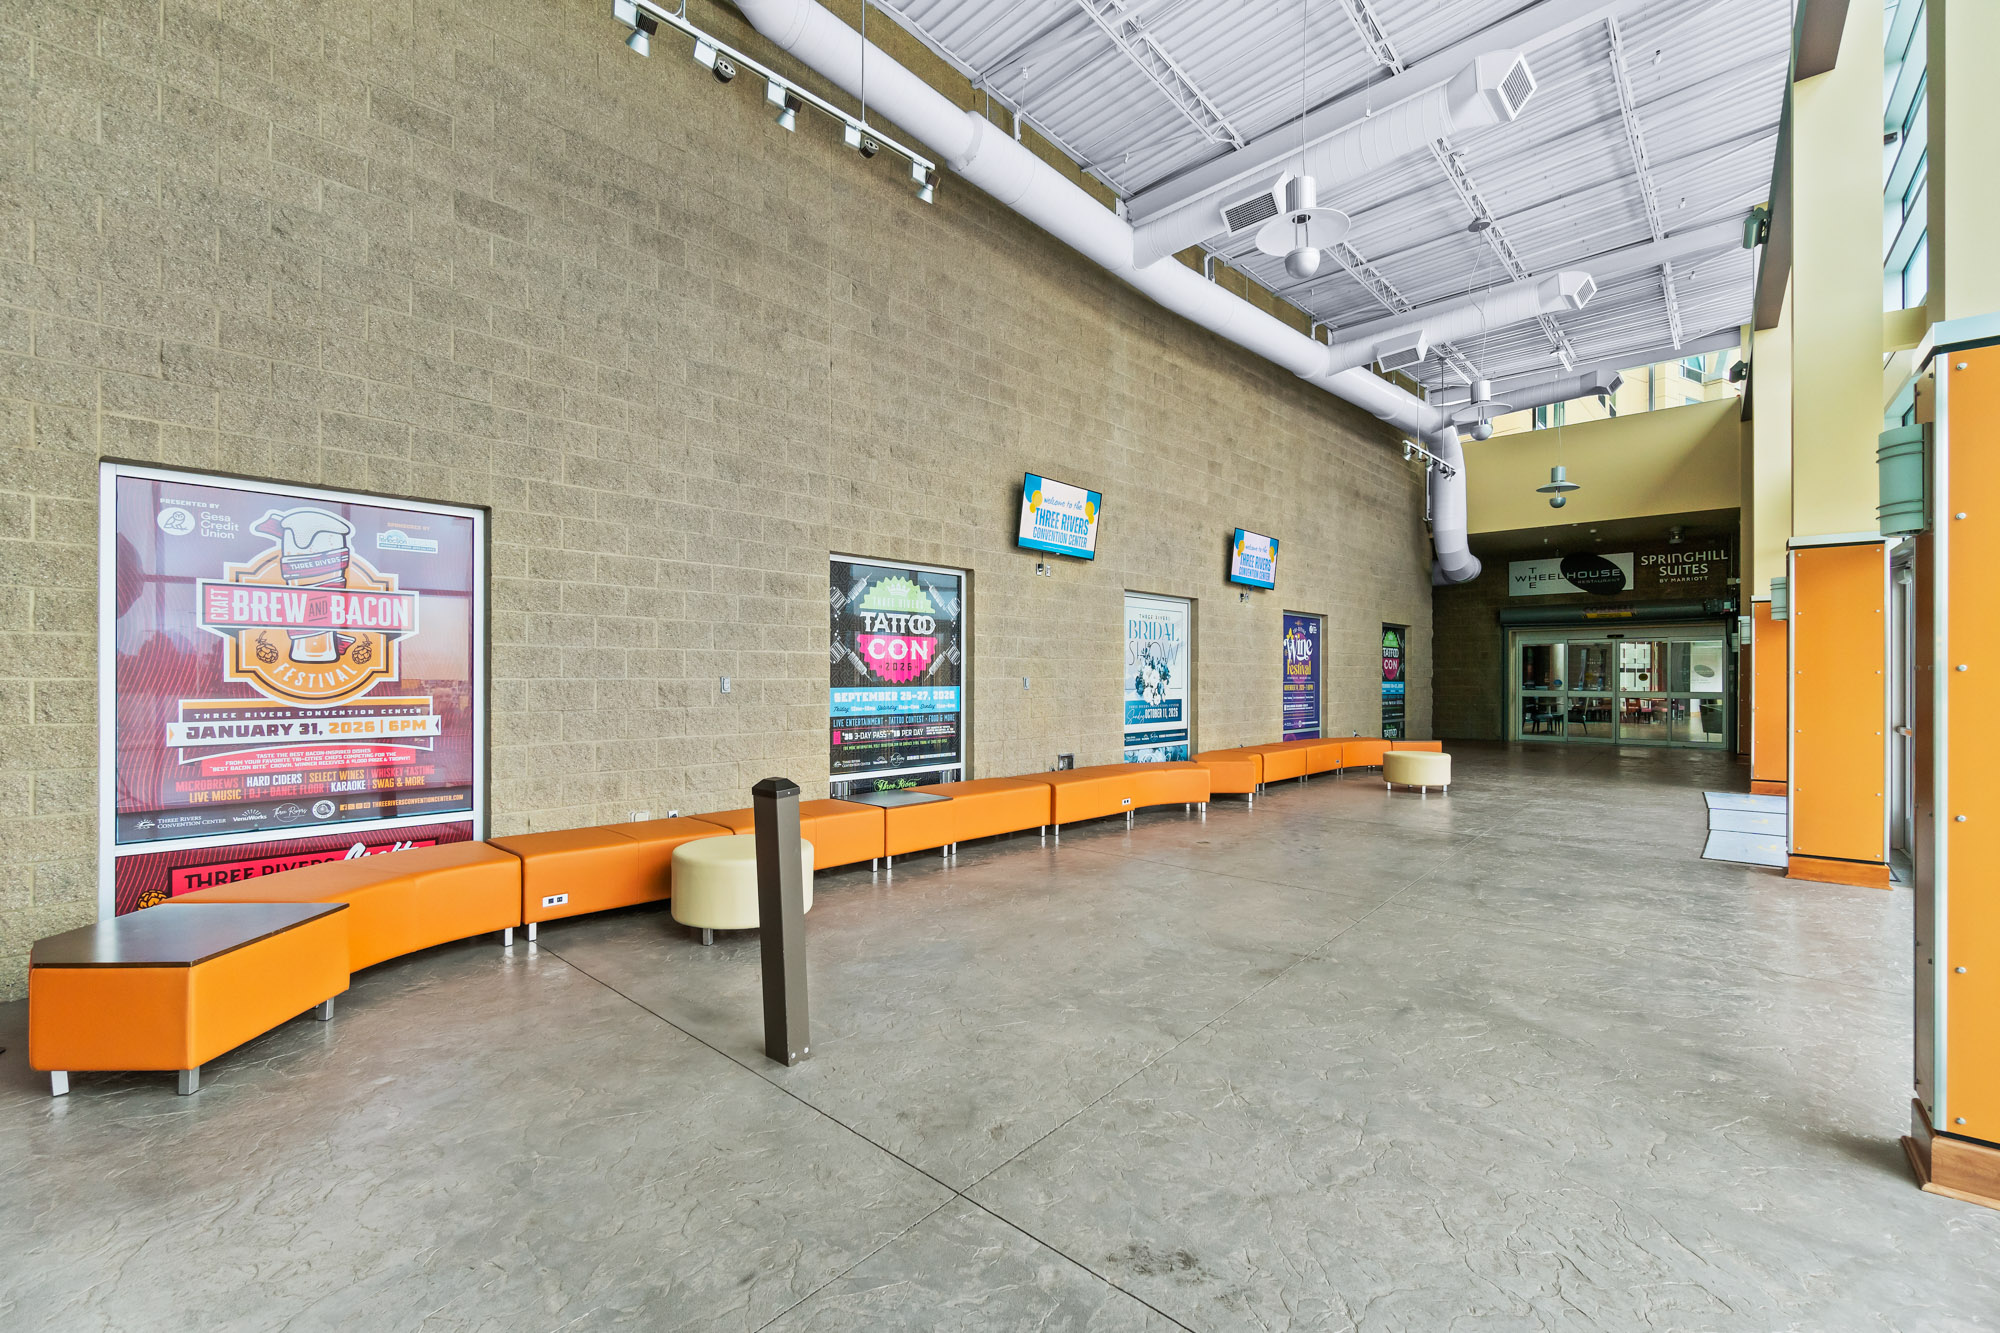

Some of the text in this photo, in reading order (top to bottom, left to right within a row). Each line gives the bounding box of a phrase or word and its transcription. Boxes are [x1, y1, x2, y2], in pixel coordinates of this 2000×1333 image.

[160, 498, 207, 508] PRESENTED
[1044, 497, 1065, 507] welcome
[1074, 501, 1082, 510] the
[200, 512, 231, 521] Gesa
[1035, 508, 1089, 535] THREE RIVERS
[200, 521, 239, 532] Credit
[200, 529, 235, 539] Union
[1033, 527, 1087, 548] CONVENTION CENTER
[290, 557, 340, 570] THREE RIVERS
[1641, 550, 1728, 566] SPRINGHILL
[1515, 569, 1621, 582] WHEELHOUSE
[1659, 564, 1708, 576] SUITES
[1529, 567, 1537, 588] THE
[210, 588, 229, 620] CRAFT
[232, 590, 408, 626] BREW AND BACON
[860, 611, 936, 634] TATTOO
[1129, 620, 1179, 641] BRIDAL
[868, 639, 928, 660] CON
[1129, 641, 1179, 665] SHOW
[1284, 635, 1313, 664] Wine
[885, 663, 912, 671] 2026
[1384, 660, 1397, 670] CON
[273, 663, 357, 688] FESTIVAL
[834, 691, 898, 702] SEPTEMBER
[1145, 708, 1162, 718] OCTOBER
[846, 717, 883, 727] ENTERTAINMENT
[186, 720, 426, 739] JANUARY 31, 2026 6PM
[854, 732, 872, 740] 3-DAY
[175, 765, 435, 792] MICROBREWS HARD CIDERS SELECT WINES WHISKEY TASTING
[190, 792, 209, 804] LIVE
[212, 789, 241, 801] MUSIC
[249, 787, 260, 798] DJ
[270, 785, 297, 796] DANCE
[300, 784, 324, 794] FLOOR
[331, 780, 366, 792] KARAOKE
[372, 778, 394, 789] SWAG
[397, 778, 402, 787] &
[405, 776, 425, 786] MORE
[372, 794, 463, 807] THREERIVERSCONVENTIONCENTER.COM
[157, 821, 200, 829] CONVENTION
